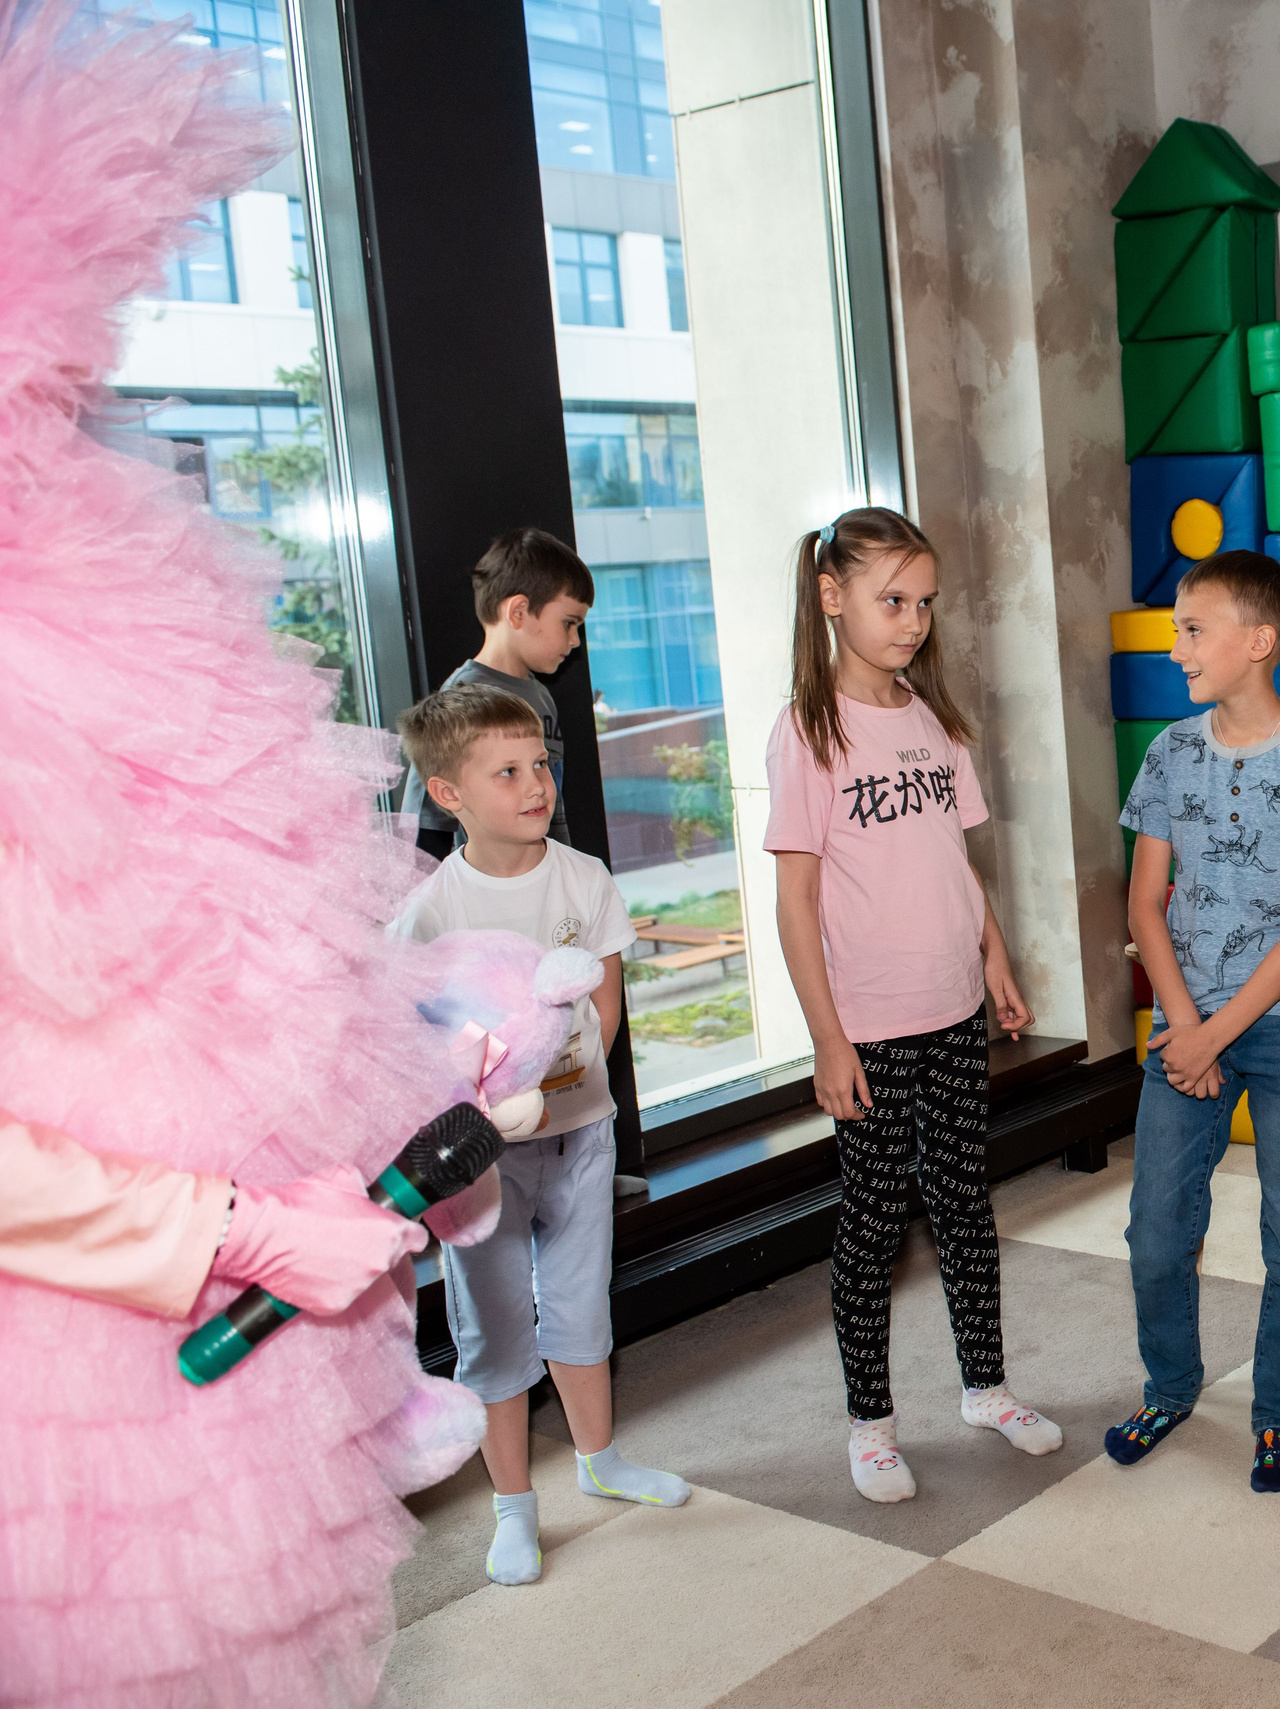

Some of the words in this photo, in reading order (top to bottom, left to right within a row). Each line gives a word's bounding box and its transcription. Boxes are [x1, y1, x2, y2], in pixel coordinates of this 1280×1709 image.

[896, 748, 931, 763] WILD
[944, 1032, 972, 1046] LIFE
[926, 1046, 949, 1060] IFE
[862, 1059, 889, 1075] LIFE
[928, 1068, 971, 1091] RULES.
[872, 1085, 909, 1099] RULES.
[953, 1096, 978, 1111] LIFE
[954, 1116, 978, 1131] LIFE
[881, 1126, 905, 1137] LIFE
[933, 1128, 958, 1145] LIFE
[843, 1130, 880, 1155] RULES.
[885, 1143, 907, 1154] LIFE
[934, 1148, 958, 1165] LIFE
[842, 1160, 865, 1185] ULES.
[865, 1159, 892, 1173] LIFE
[869, 1177, 895, 1191] LIFE
[941, 1173, 979, 1196] RULES.
[852, 1186, 877, 1205] LIFE
[857, 1263, 881, 1275] LIFE
[832, 1264, 853, 1289] ULES.
[858, 1280, 883, 1290] LIFE
[956, 1280, 989, 1293] RULE
[840, 1290, 866, 1306] LIFE
[976, 1299, 998, 1309] LIFE
[964, 1314, 983, 1325] IFE
[841, 1341, 877, 1359] RULES.
[864, 1362, 885, 1374] LIFE
[854, 1393, 877, 1407] LIFE
